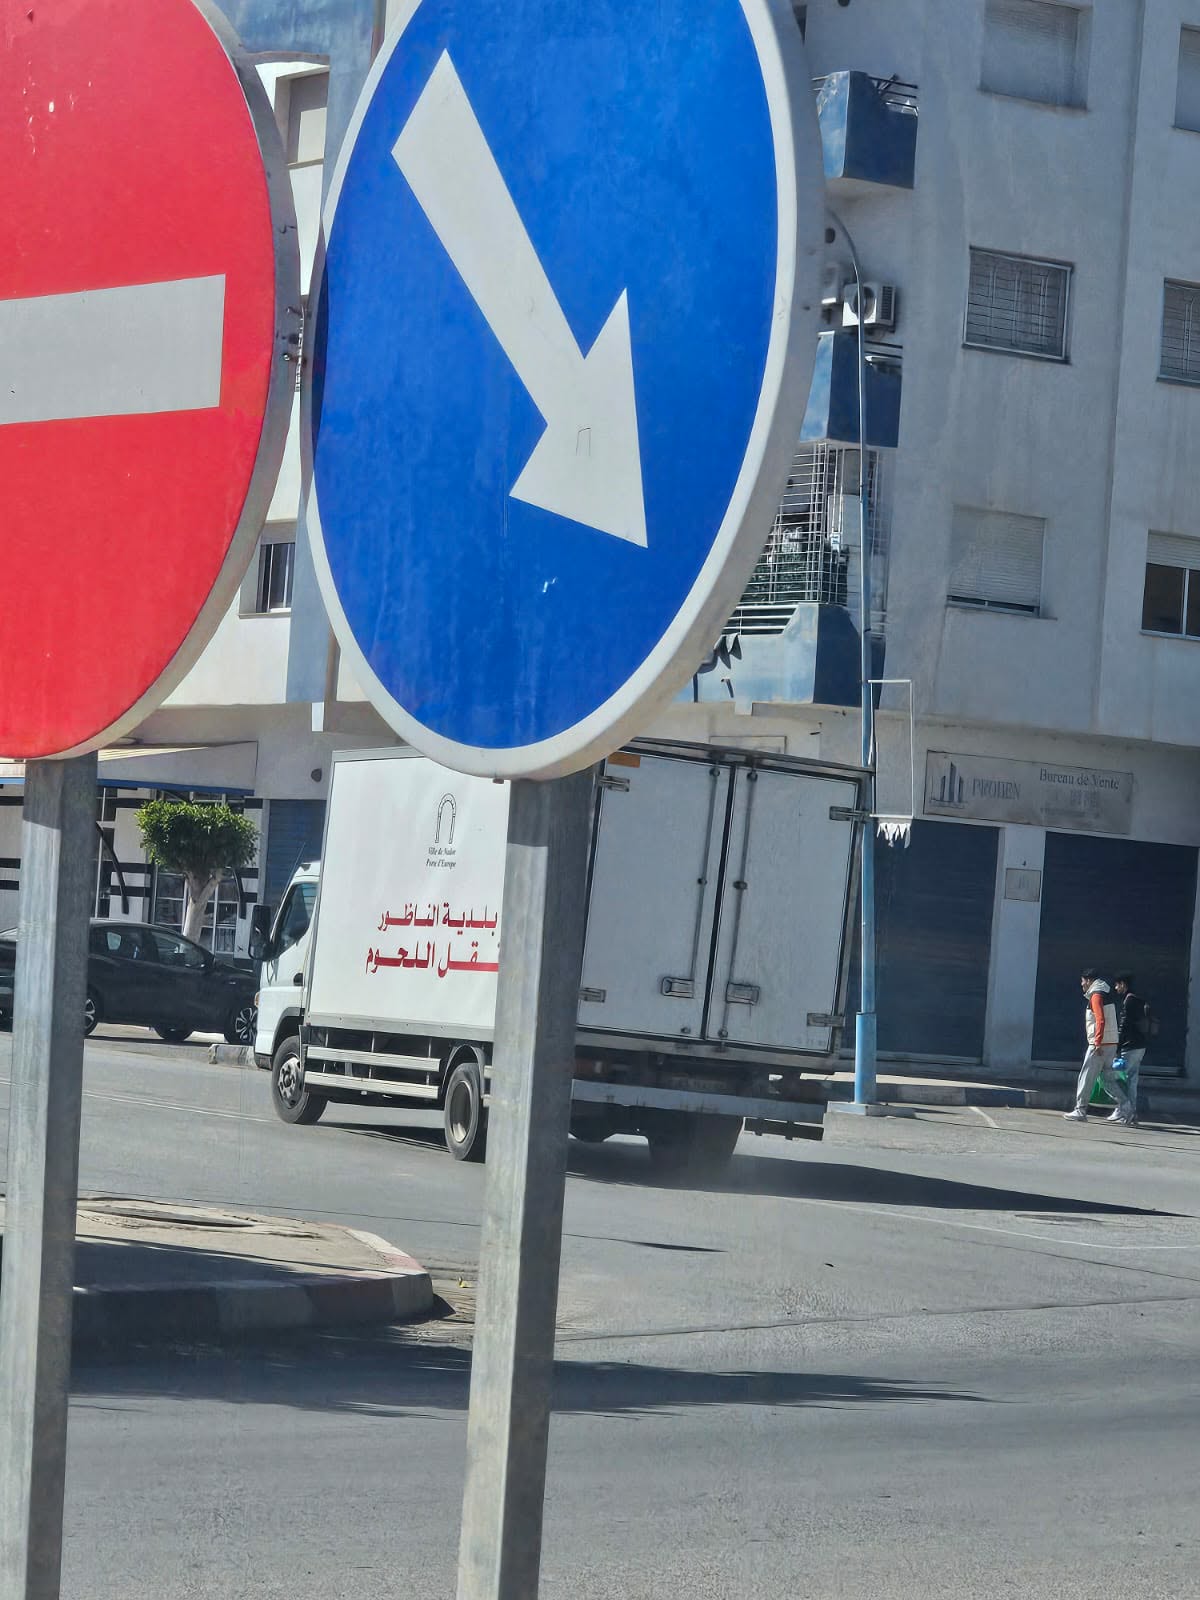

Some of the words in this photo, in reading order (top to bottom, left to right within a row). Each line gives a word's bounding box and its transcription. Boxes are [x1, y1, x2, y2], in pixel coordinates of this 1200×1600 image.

[1040, 767, 1074, 785] Bureau
[1077, 772, 1089, 786] de
[1091, 774, 1119, 790] Vente
[377, 903, 440, 932] الناظور
[442, 902, 498, 936] بلدية
[365, 941, 435, 975] اللحوم
